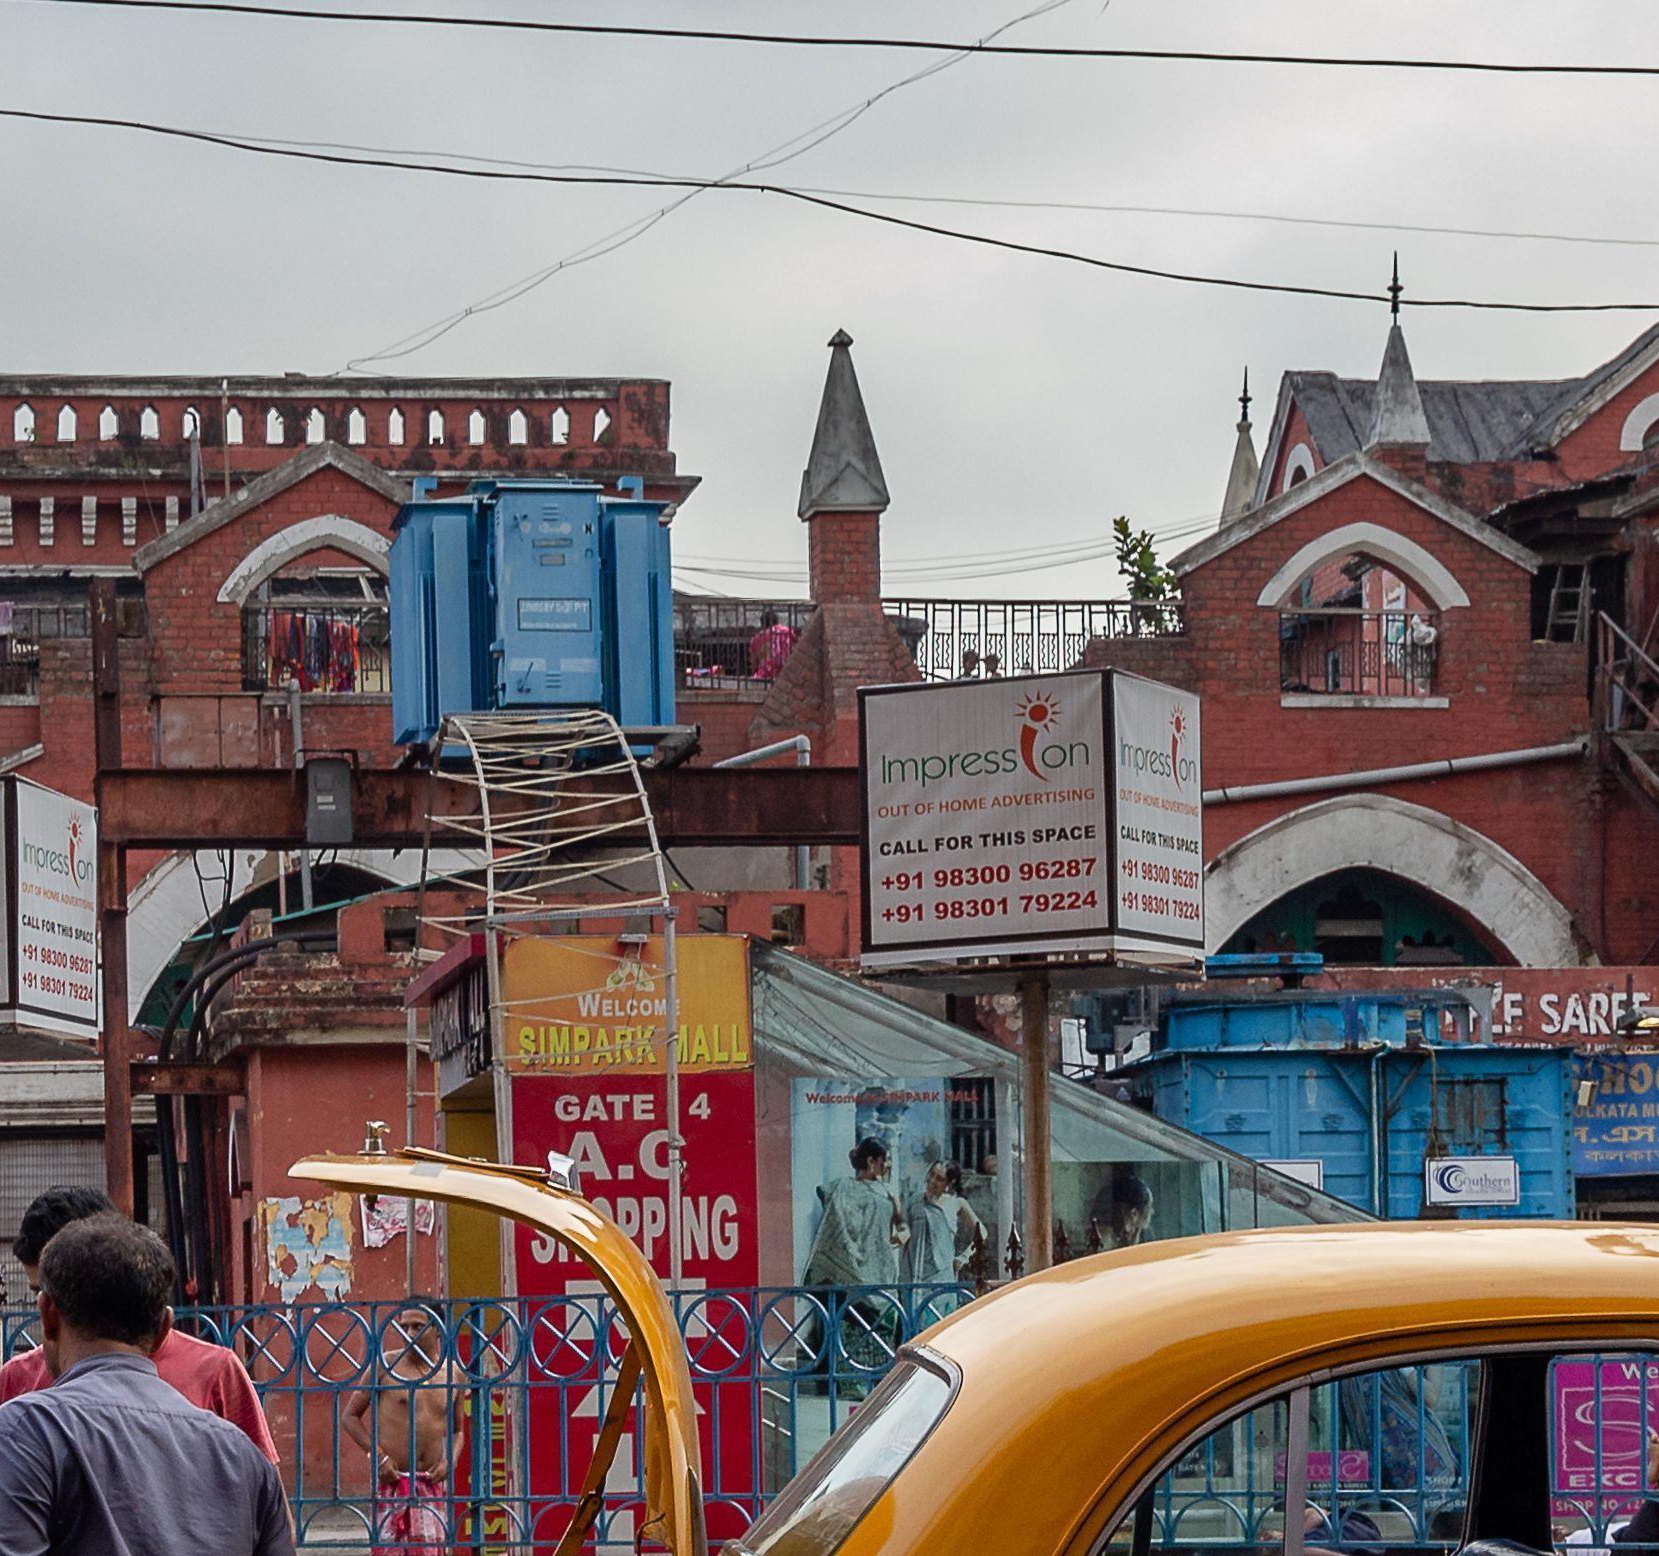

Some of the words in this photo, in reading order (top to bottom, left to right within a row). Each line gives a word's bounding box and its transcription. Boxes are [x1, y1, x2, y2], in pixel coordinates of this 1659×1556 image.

[882, 724, 1089, 787] Impression
[1120, 733, 1197, 792] Impression
[878, 804, 909, 818] OUT
[914, 801, 934, 815] OF
[939, 797, 986, 813] HOME
[991, 788, 1095, 809] ADVERTISING
[879, 842, 928, 856] CALL
[935, 836, 972, 851] FOR
[979, 831, 1025, 848] THIS
[1032, 825, 1096, 843] SPACE
[1120, 825, 1139, 842] CALL
[1141, 828, 1157, 846] FOR
[1158, 832, 1175, 851] THIS
[1176, 836, 1199, 855] SPACE
[23, 836, 94, 890] Impression
[882, 871, 923, 892] +91
[934, 864, 1010, 888] 98300
[1019, 858, 1097, 881] 96287
[1121, 859, 1139, 879] +91
[1141, 861, 1170, 886] 98300
[1172, 865, 1199, 890] 96287
[882, 903, 923, 923] +91
[934, 897, 1009, 920] 98301
[1019, 890, 1097, 913] 79224
[1121, 892, 1139, 912] +91
[1141, 894, 1170, 916] 98301
[1172, 898, 1200, 921] 79224
[22, 914, 39, 928] CALL
[41, 917, 56, 933] FOR
[57, 922, 73, 938] THIS
[75, 926, 94, 945] SPACE
[22, 945, 38, 962] +91
[40, 946, 68, 969] 98300
[69, 951, 93, 975] 96287
[22, 972, 38, 991] +91
[40, 974, 66, 995] 98301
[68, 978, 93, 1002] 79224
[577, 993, 681, 1018] WELCOM
[519, 1024, 657, 1066] SIMPARK
[555, 1094, 655, 1122] GATE
[689, 1092, 711, 1120] 4
